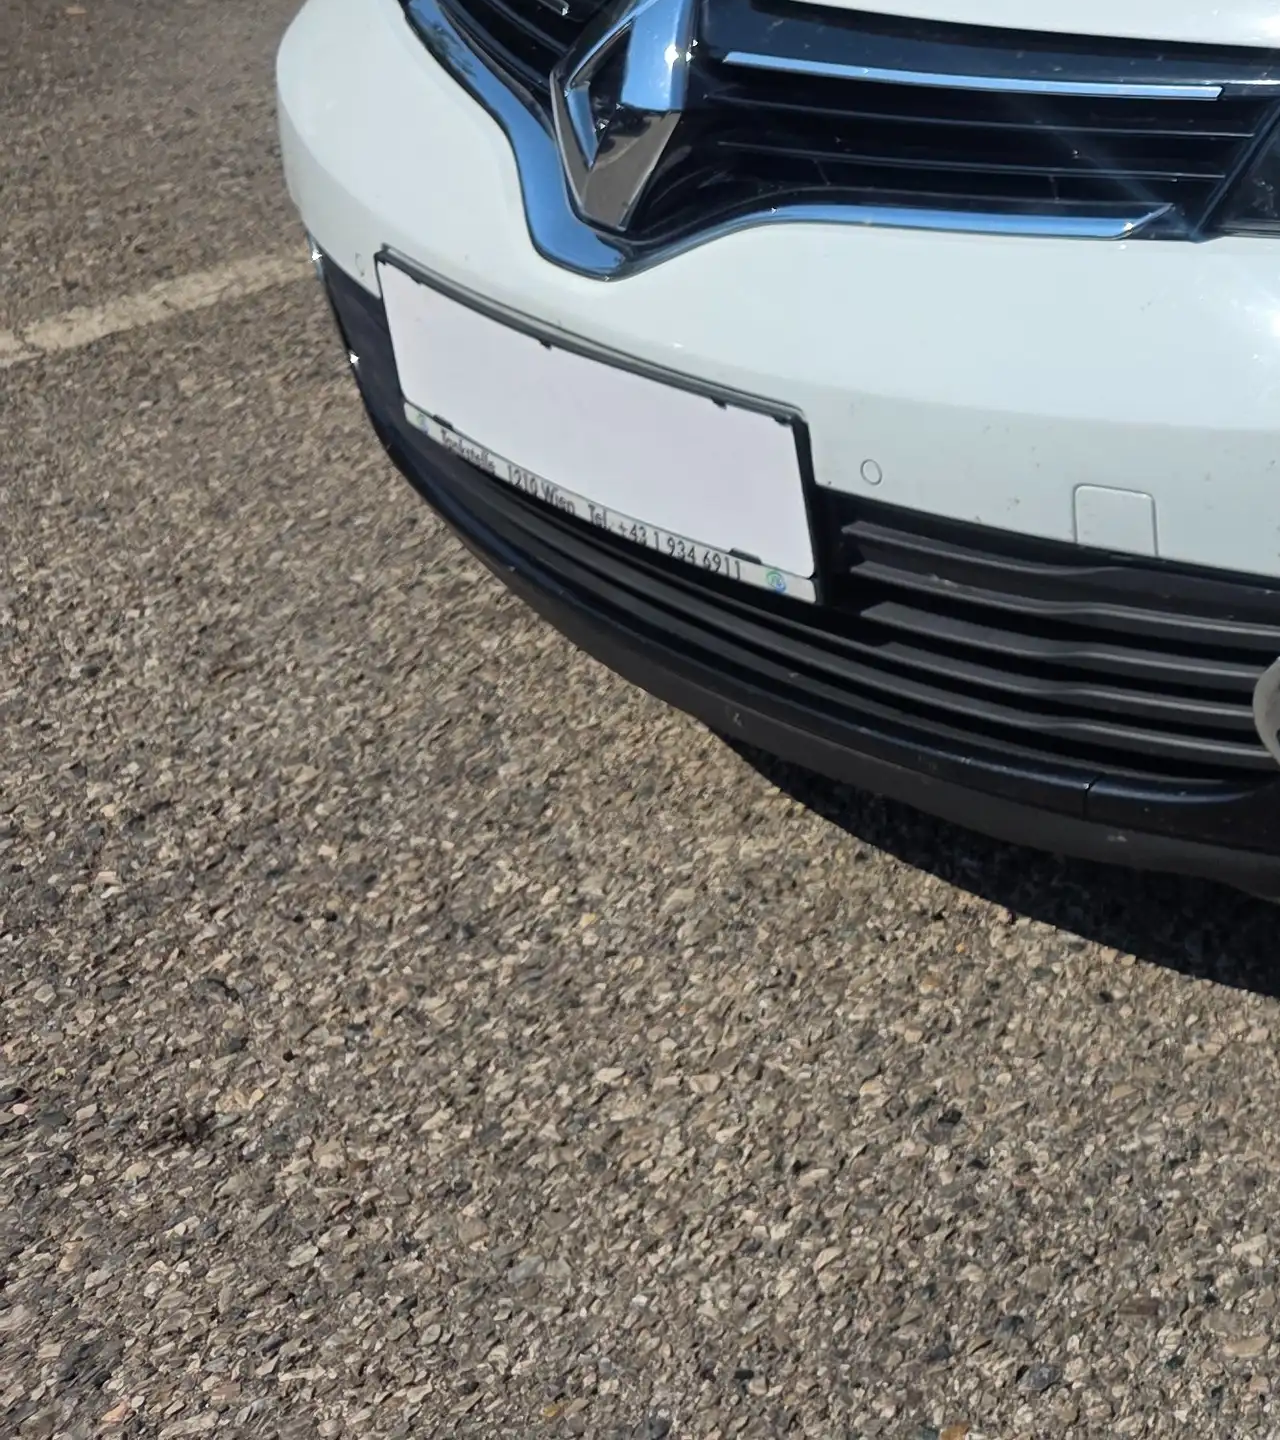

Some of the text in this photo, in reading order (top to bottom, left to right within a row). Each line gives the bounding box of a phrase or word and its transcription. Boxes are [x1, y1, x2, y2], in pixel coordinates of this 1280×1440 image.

[540, 480, 575, 515] Wien
[667, 537, 695, 565] 934
[703, 551, 741, 581] 6911
